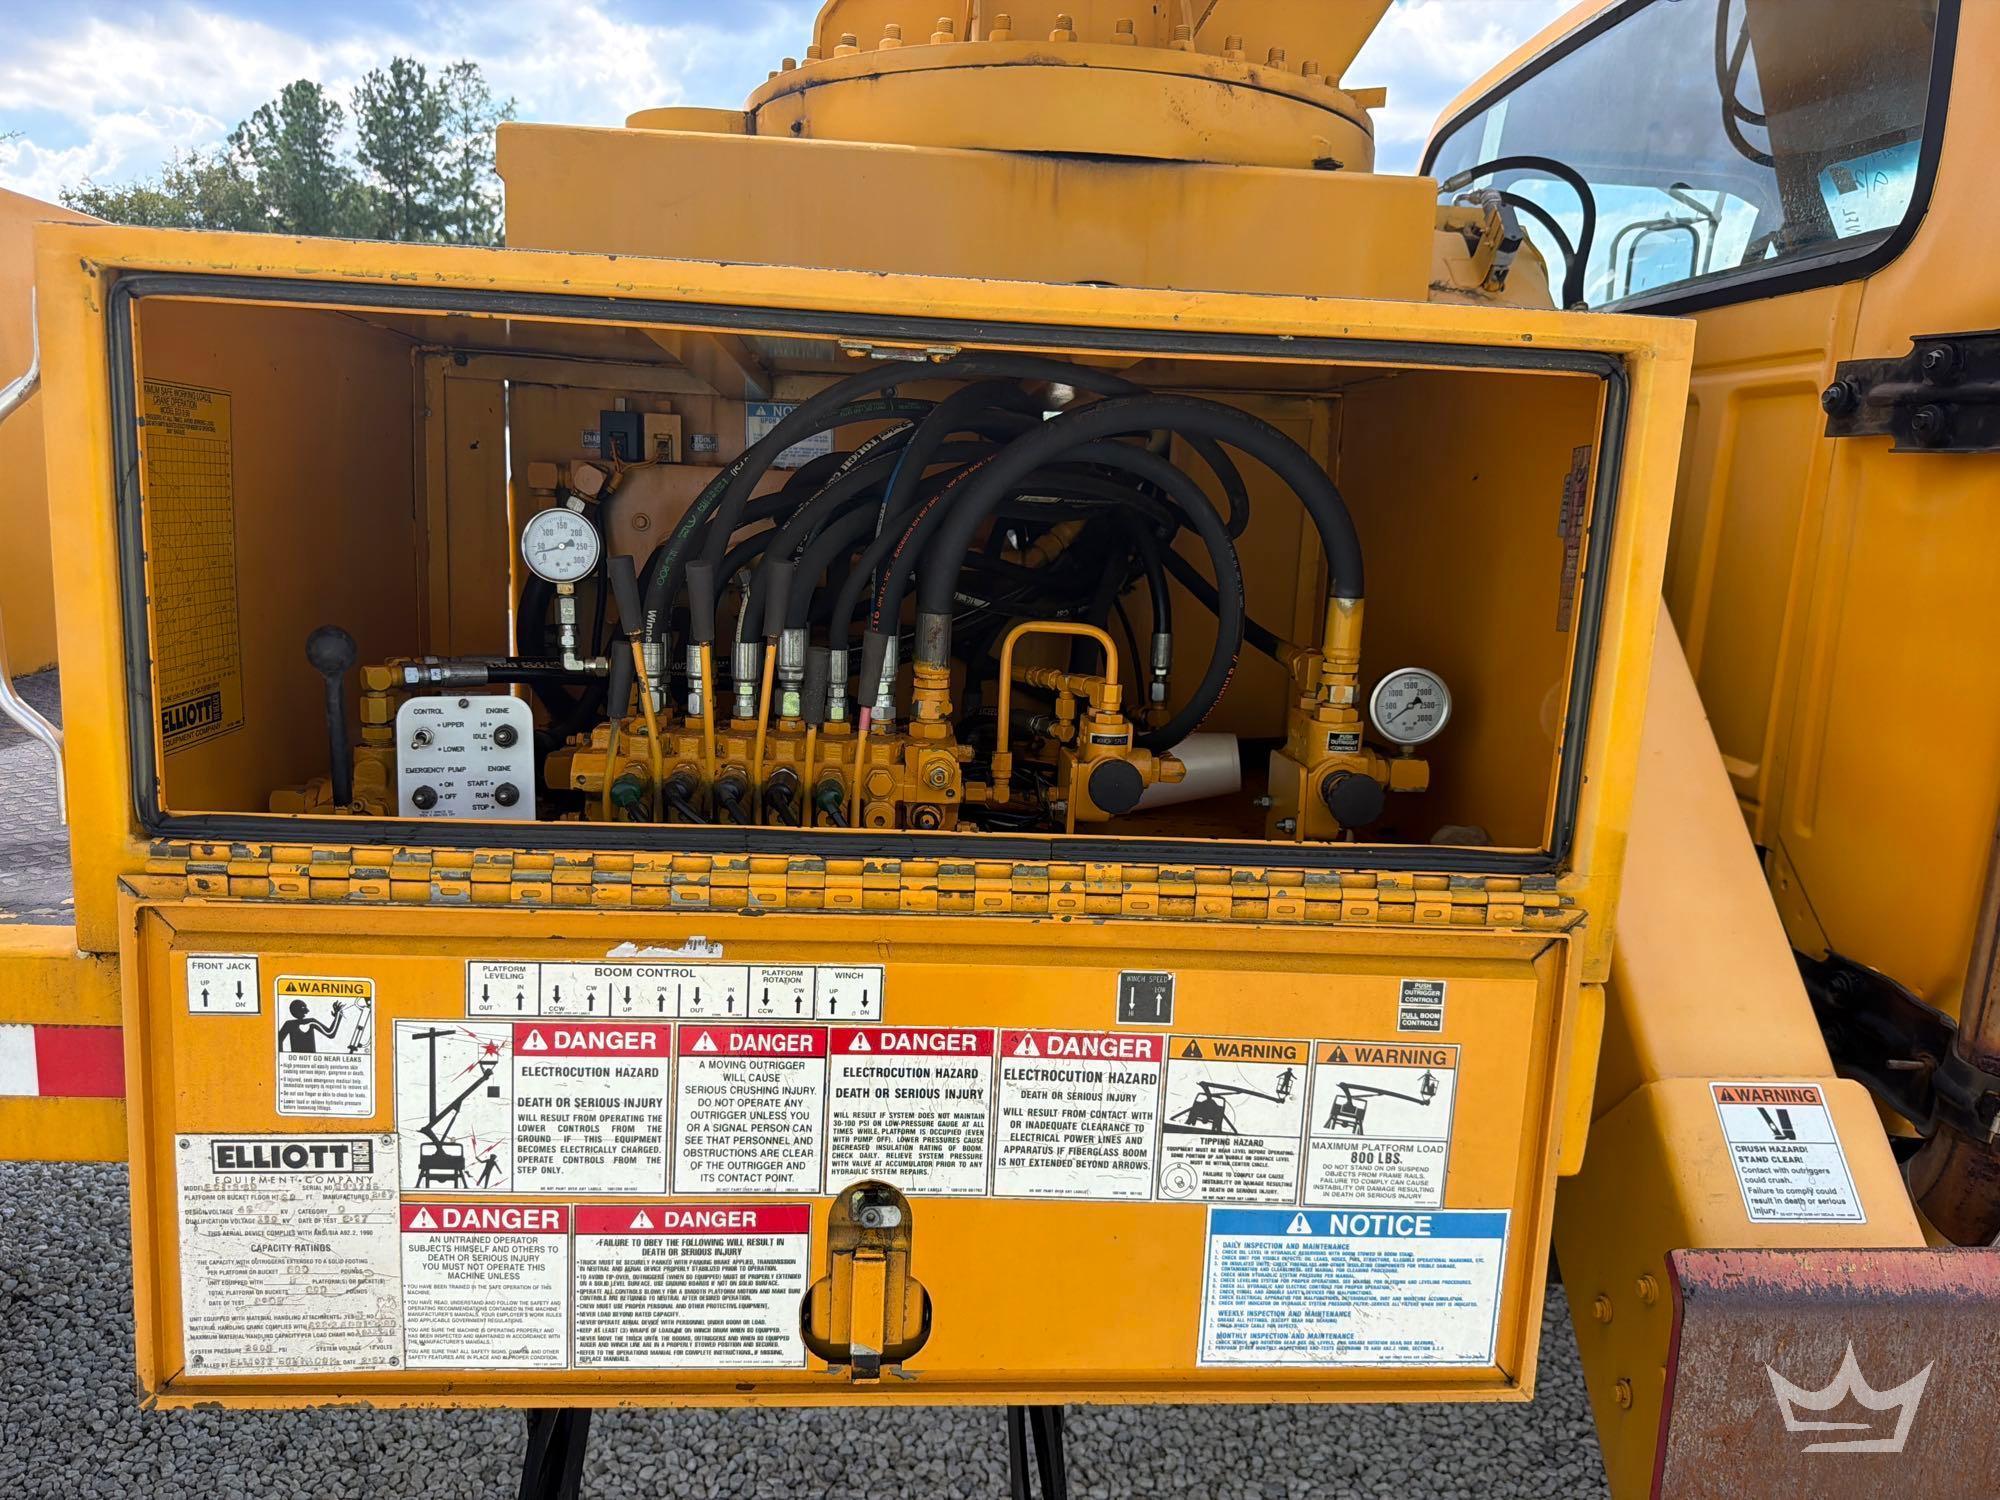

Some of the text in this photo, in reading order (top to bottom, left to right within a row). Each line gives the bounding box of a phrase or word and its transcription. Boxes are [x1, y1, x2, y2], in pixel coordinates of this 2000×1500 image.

[840, 438, 880, 470] TOUGH
[537, 542, 546, 550] 50
[576, 542, 588, 550] 250
[1388, 689, 1403, 697] 1000
[162, 699, 211, 734] ELLIOTT
[1417, 714, 1432, 722] 3000
[191, 961, 251, 970] FRONT JACK
[482, 965, 526, 974] PLATFORM
[594, 967, 696, 977] BOOM CONTROL
[761, 969, 803, 978] PLATFORM
[762, 976, 801, 985] ROTATION
[298, 982, 364, 994] WARNING
[1413, 982, 1432, 990] PUSH
[1404, 988, 1440, 996] OUTRIGGER
[1403, 996, 1438, 1004] CONTROLS
[548, 1005, 567, 1013] CCW
[1419, 1011, 1442, 1020] BOOM
[554, 1030, 656, 1049] DANGER
[729, 1033, 812, 1052] DANGER
[880, 1032, 976, 1051] DANGER
[1047, 1035, 1151, 1058] DANGER
[1213, 1042, 1296, 1059] WARNING
[1354, 1047, 1446, 1065] WARNING
[698, 1060, 805, 1070] A MOVING OUTRIGGER
[521, 1066, 658, 1077] ELECTROCUTION HAZARD
[843, 1066, 978, 1079] ELECTROCUTION HAZARD
[1003, 1068, 1157, 1085] ELECTROCUTION HAZARD
[722, 1072, 780, 1083] WILL CAUSE
[684, 1085, 815, 1095] SERIOUS CRUSHING INJURY.
[835, 1087, 983, 1099] DEATH OR SERIOUS INJURY
[1734, 1088, 1816, 1102] WARNING
[1020, 1089, 1136, 1102] DEATH OR SERIOUS INJURY
[517, 1097, 662, 1108] DEATH OR SERIOUS INJURY
[1200, 1137, 1263, 1147] TIPPING HAZARD
[1311, 1141, 1443, 1153] MAXIMUM PLATFORM LOAD
[216, 1144, 348, 1169] ELLIOTT
[1350, 1151, 1402, 1164] 800 LBS.
[1790, 1166, 1830, 1176] outriggers
[215, 1176, 373, 1184] EQUIPMENT COMPANY
[1747, 1186, 1774, 1194] Failure
[1785, 1186, 1813, 1196] comply
[1783, 1197, 1806, 1205] death
[1753, 1207, 1778, 1215] injury.
[442, 1208, 559, 1229] DANGER
[664, 1211, 756, 1227] DANGER
[1329, 1214, 1431, 1236] NOTICE
[429, 1235, 538, 1244] AN UNTRAINED OPERATOR
[250, 1243, 331, 1253] CAPACITY RATINGS
[1222, 1241, 1241, 1251] DAILY
[1243, 1241, 1283, 1249] INSPECTION
